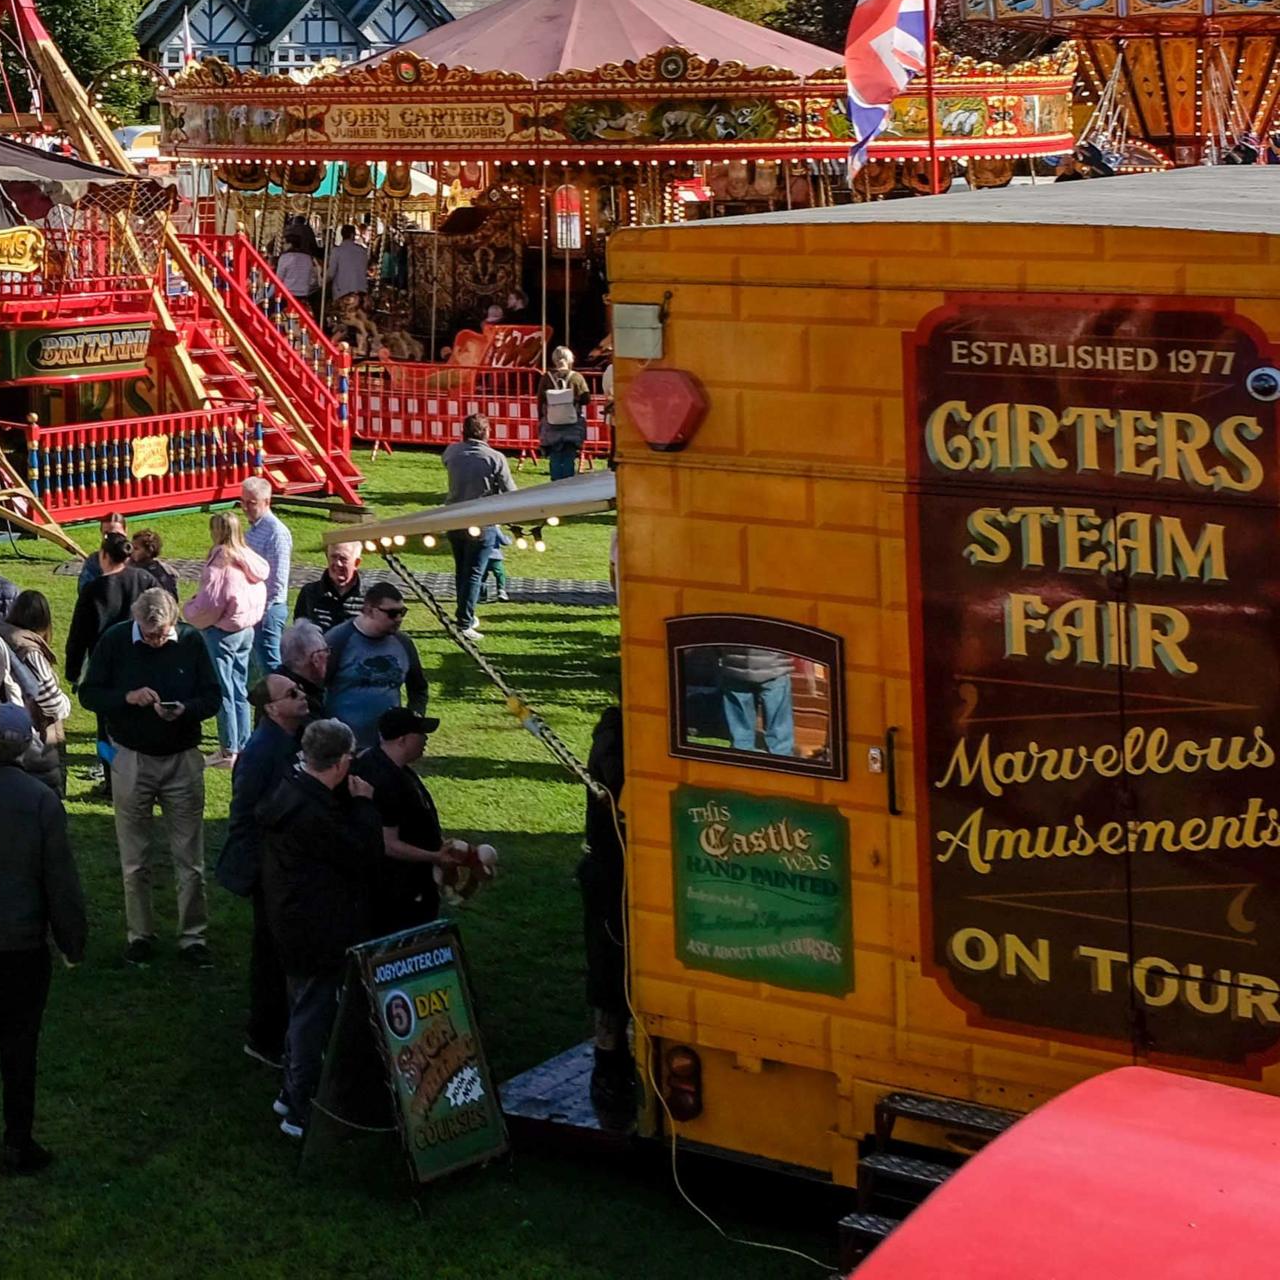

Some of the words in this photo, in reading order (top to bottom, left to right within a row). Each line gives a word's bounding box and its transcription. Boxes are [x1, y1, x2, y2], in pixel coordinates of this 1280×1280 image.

[330, 107, 390, 127] JOHN
[399, 106, 506, 127] CARTER'S
[331, 128, 378, 140] JUBILEE
[382, 126, 426, 140] STEAM
[431, 126, 507, 140] GALLOPERS
[950, 341, 1159, 374] ESTABLISHED
[1166, 348, 1236, 377] 1977
[925, 400, 1264, 493] CARTERS
[962, 506, 1229, 585] STEAM
[1003, 592, 1200, 678] FAIR
[934, 725, 1275, 797] Marvellous
[687, 800, 731, 824] THIS
[699, 818, 813, 862] Castle
[935, 797, 1280, 874] Amusements
[686, 855, 747, 881] HAND
[750, 866, 840, 897] PAINTED
[779, 853, 833, 872] WAS
[373, 946, 454, 984] JOBYCARTER.COM
[687, 938, 712, 958] ASK
[713, 943, 755, 960] ABOUT
[756, 943, 783, 959] OUR
[782, 936, 843, 965] COURSES
[952, 926, 1051, 984] ON
[1073, 942, 1280, 1025] TOUR
[415, 989, 453, 1020] DAY
[451, 1077, 468, 1100] BOOK
[462, 1076, 480, 1100] NOW
[414, 1107, 489, 1151] COURSES
